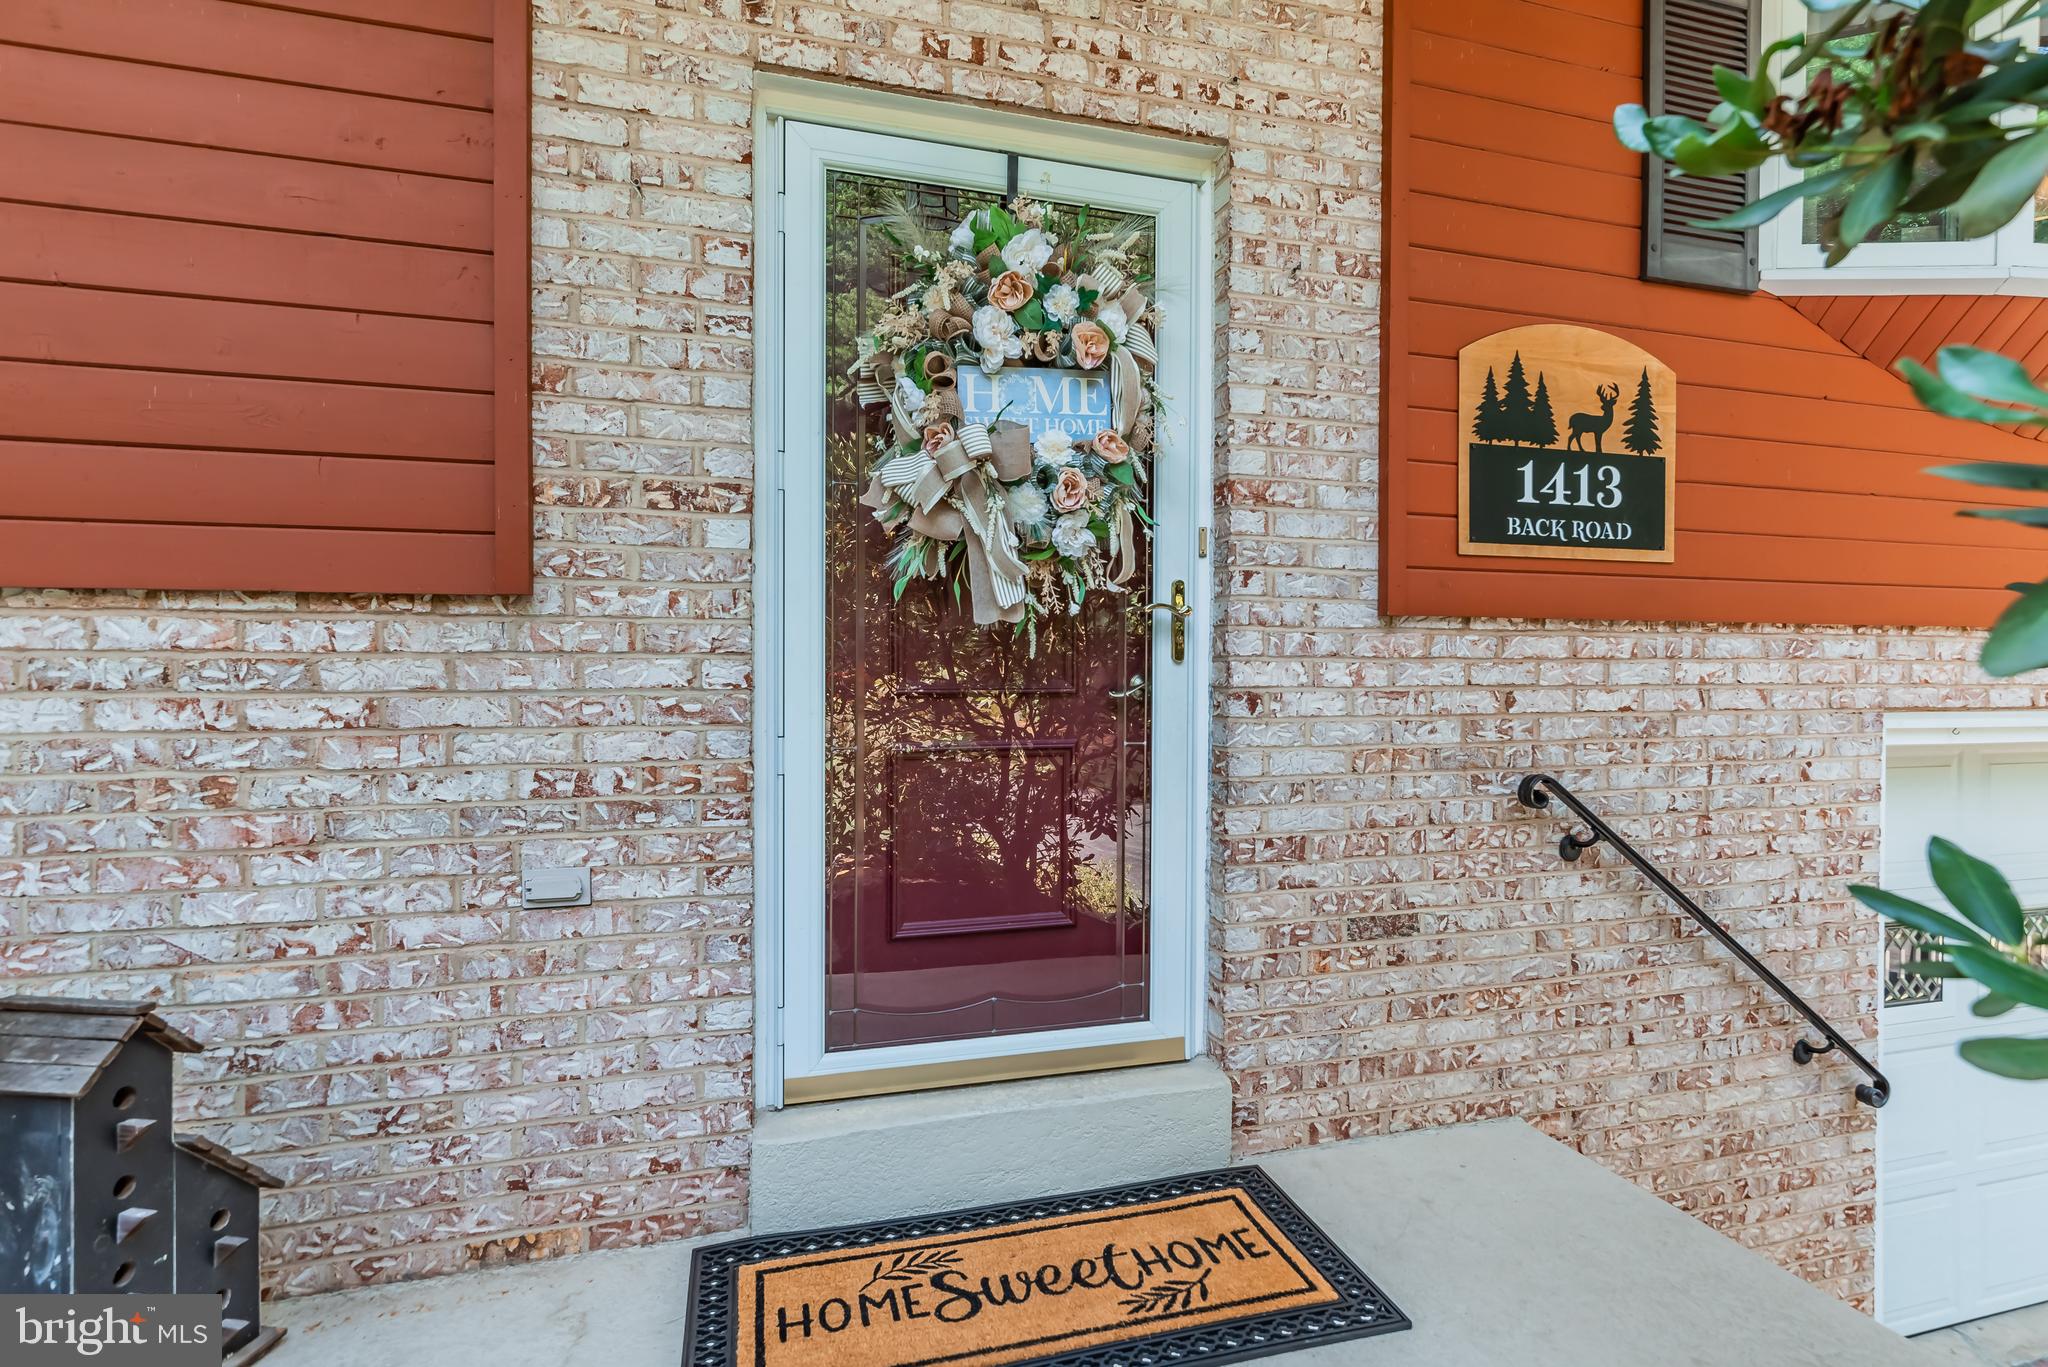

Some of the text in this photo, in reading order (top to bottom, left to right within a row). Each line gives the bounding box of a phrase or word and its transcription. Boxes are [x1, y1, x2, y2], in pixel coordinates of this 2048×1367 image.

[1045, 418, 1106, 435] HOME
[1516, 459, 1623, 508] 1413
[1506, 517, 1632, 543] BACK ROAD
[776, 1228, 1271, 1343] HOME Sweet HOME
